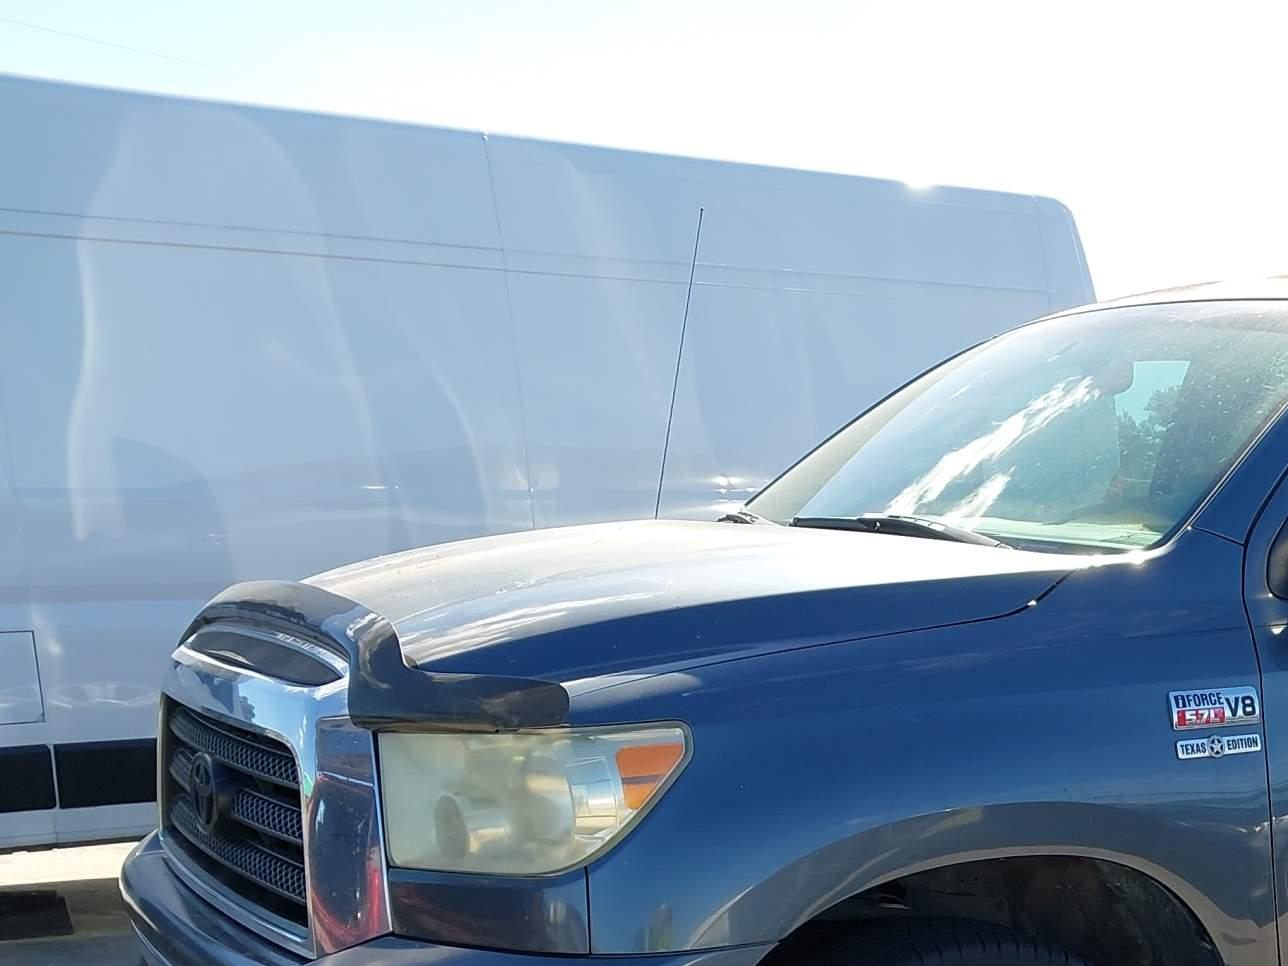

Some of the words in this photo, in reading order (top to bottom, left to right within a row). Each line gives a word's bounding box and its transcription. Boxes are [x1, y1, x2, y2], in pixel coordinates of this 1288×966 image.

[1224, 695, 1257, 718] V8
[1180, 742, 1207, 756] TEXAS
[1227, 736, 1259, 751] EDITION
